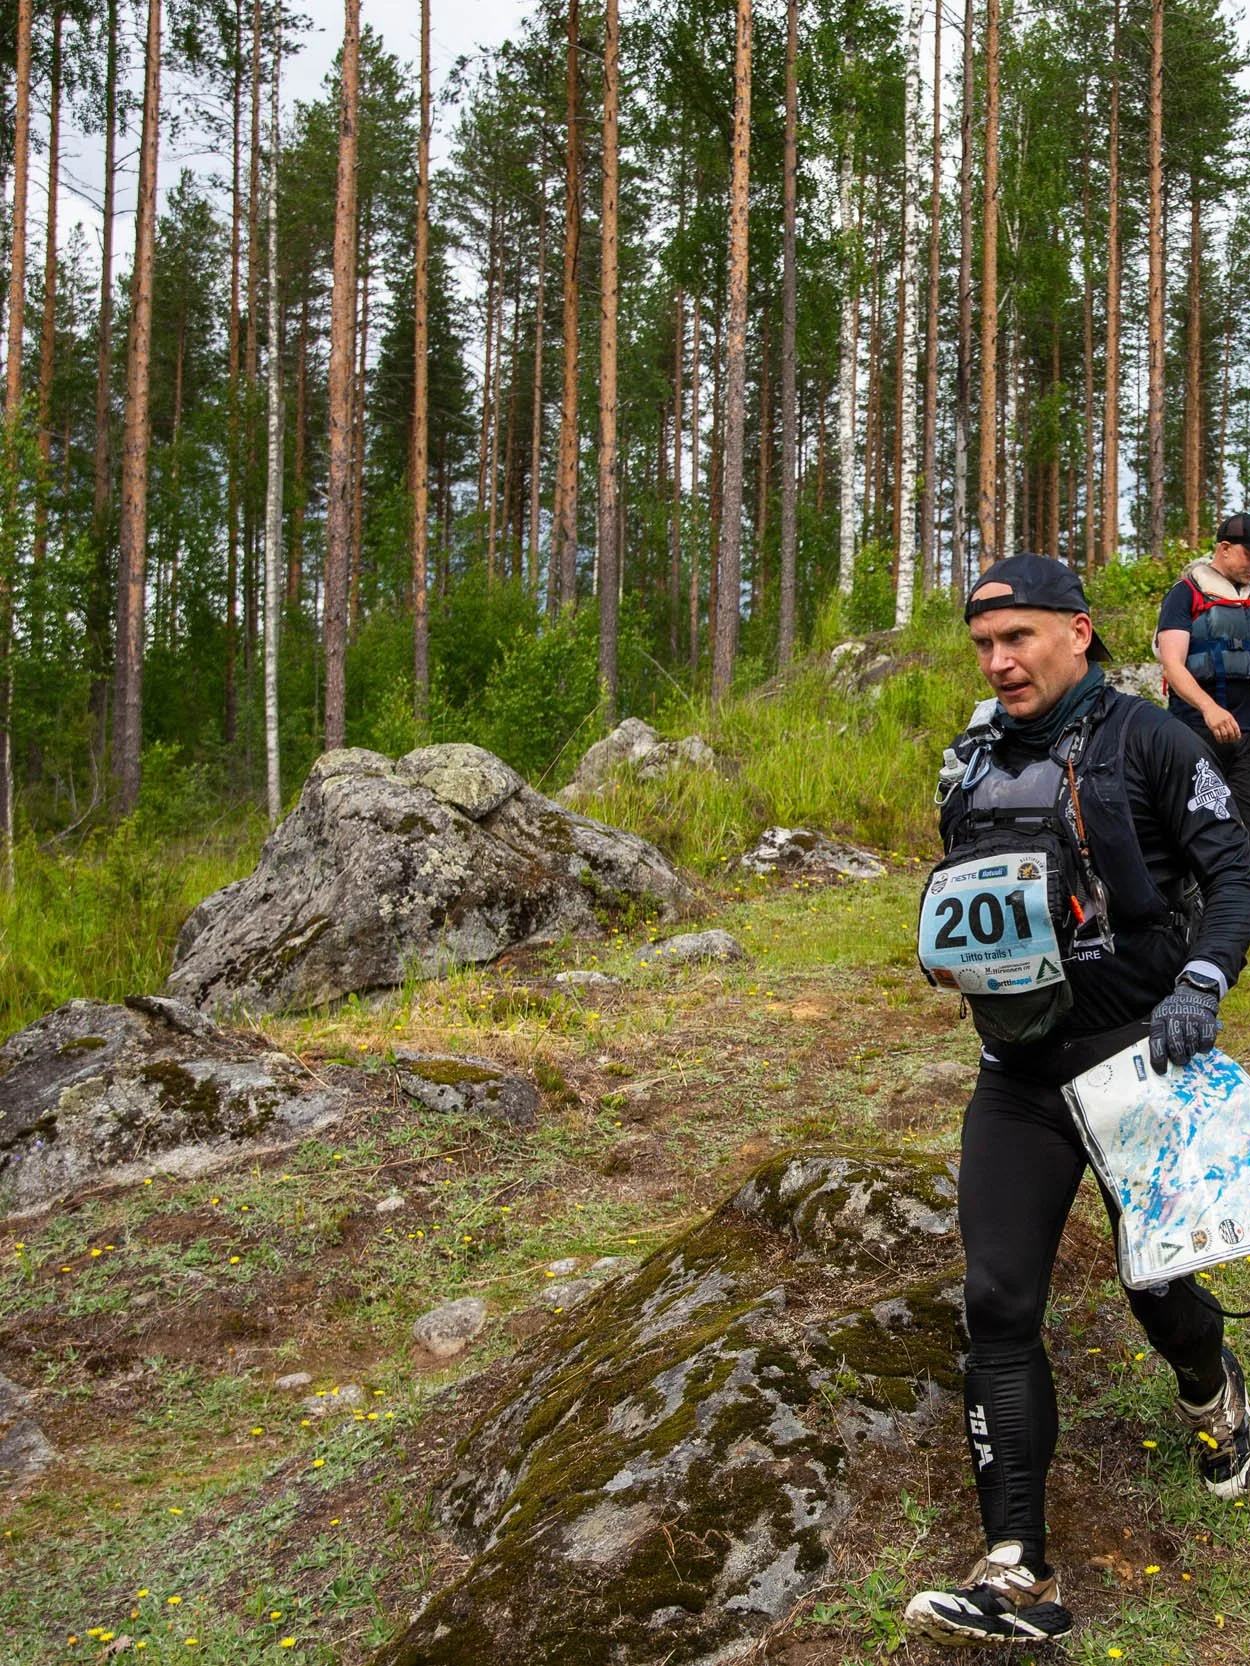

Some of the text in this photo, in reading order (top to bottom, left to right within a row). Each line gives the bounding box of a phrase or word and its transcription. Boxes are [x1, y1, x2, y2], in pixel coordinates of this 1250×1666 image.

[935, 890, 1032, 949] 201
[960, 952, 983, 962] Liitto
[985, 949, 1006, 960] trails
[1076, 950, 1101, 960] URE
[1155, 1003, 1205, 1018] Mechanix
